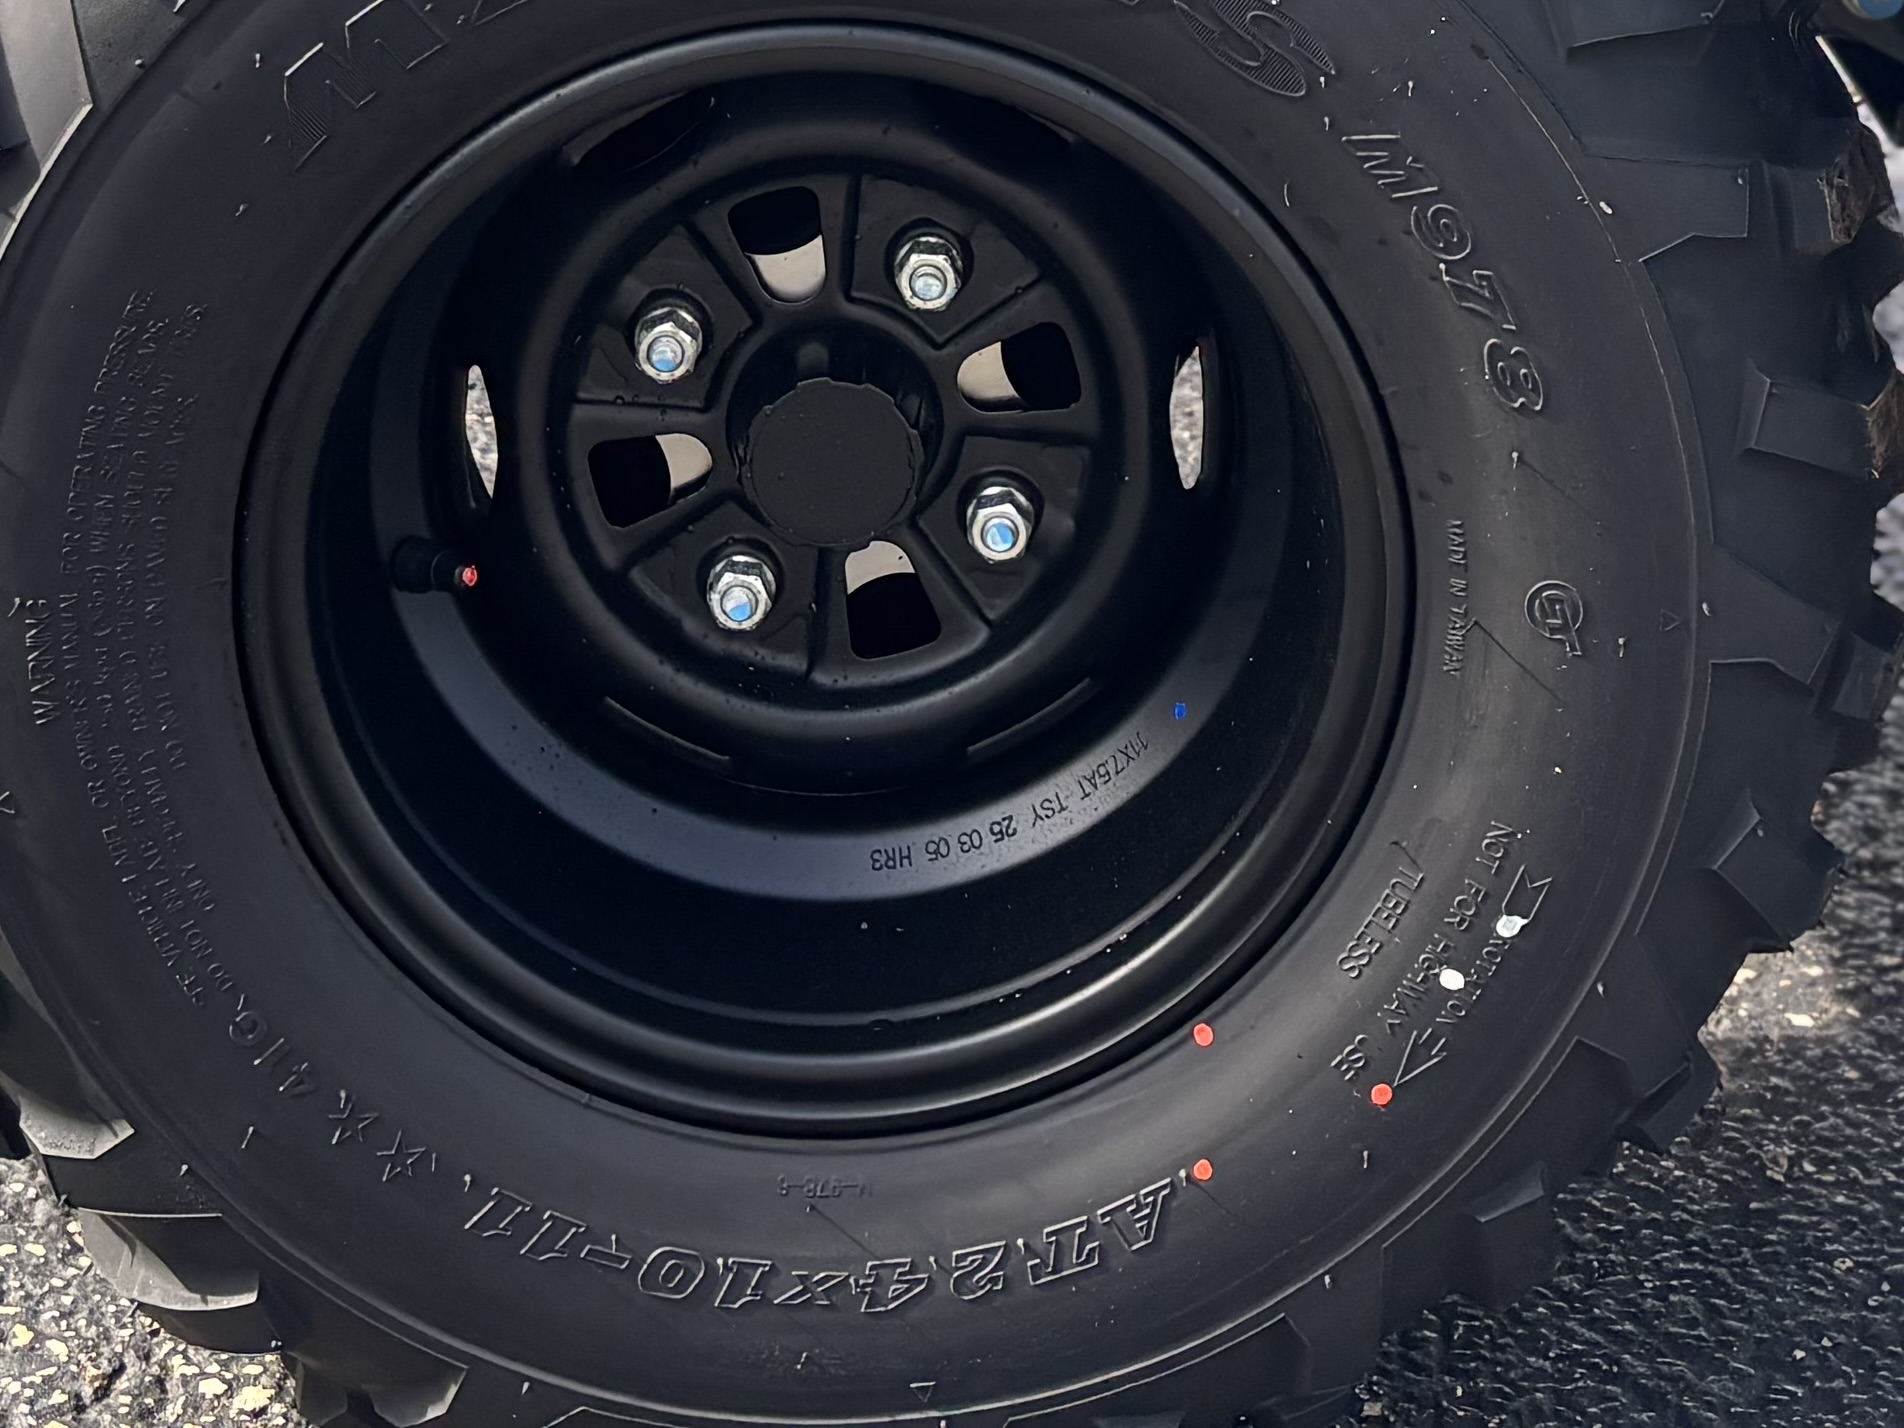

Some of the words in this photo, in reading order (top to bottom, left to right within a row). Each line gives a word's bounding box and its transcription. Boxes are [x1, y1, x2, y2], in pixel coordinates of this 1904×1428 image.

[1339, 124, 1548, 412] M978
[21, 598, 57, 726] WARNING
[988, 814, 1018, 845] 25
[1030, 790, 1070, 830] TSY
[870, 844, 913, 872] HR3
[924, 838, 951, 861] 05
[957, 828, 984, 851] 03
[1474, 820, 1514, 876] NOT
[1336, 866, 1425, 980] TUBELESS
[1443, 878, 1487, 933] FOR
